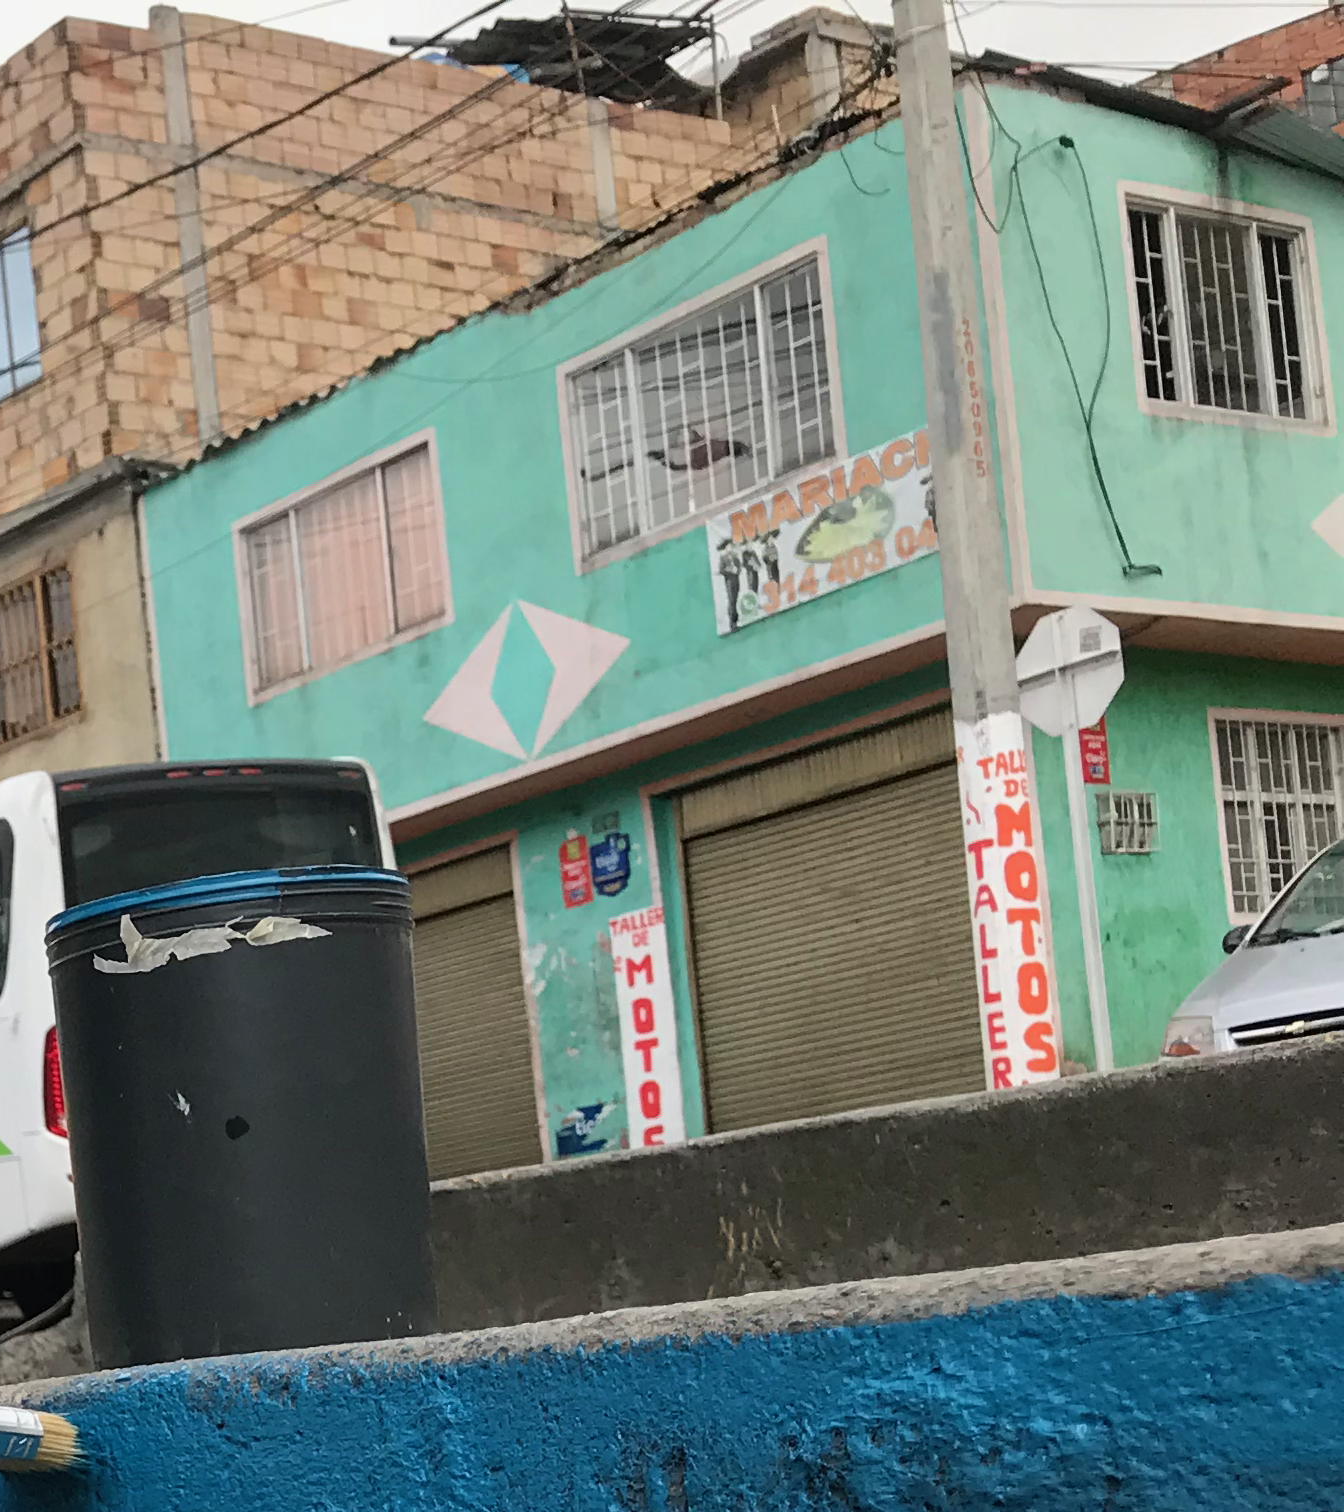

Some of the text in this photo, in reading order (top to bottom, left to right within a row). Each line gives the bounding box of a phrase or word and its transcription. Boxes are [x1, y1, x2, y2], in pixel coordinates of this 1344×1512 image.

[762, 563, 819, 614] 314
[827, 537, 888, 584] 403
[1003, 777, 1030, 799] DE
[609, 906, 665, 937] TALLER
[631, 930, 650, 948] DE
[994, 801, 1058, 1074] MOTOS
[967, 838, 1012, 1091] TALLER
